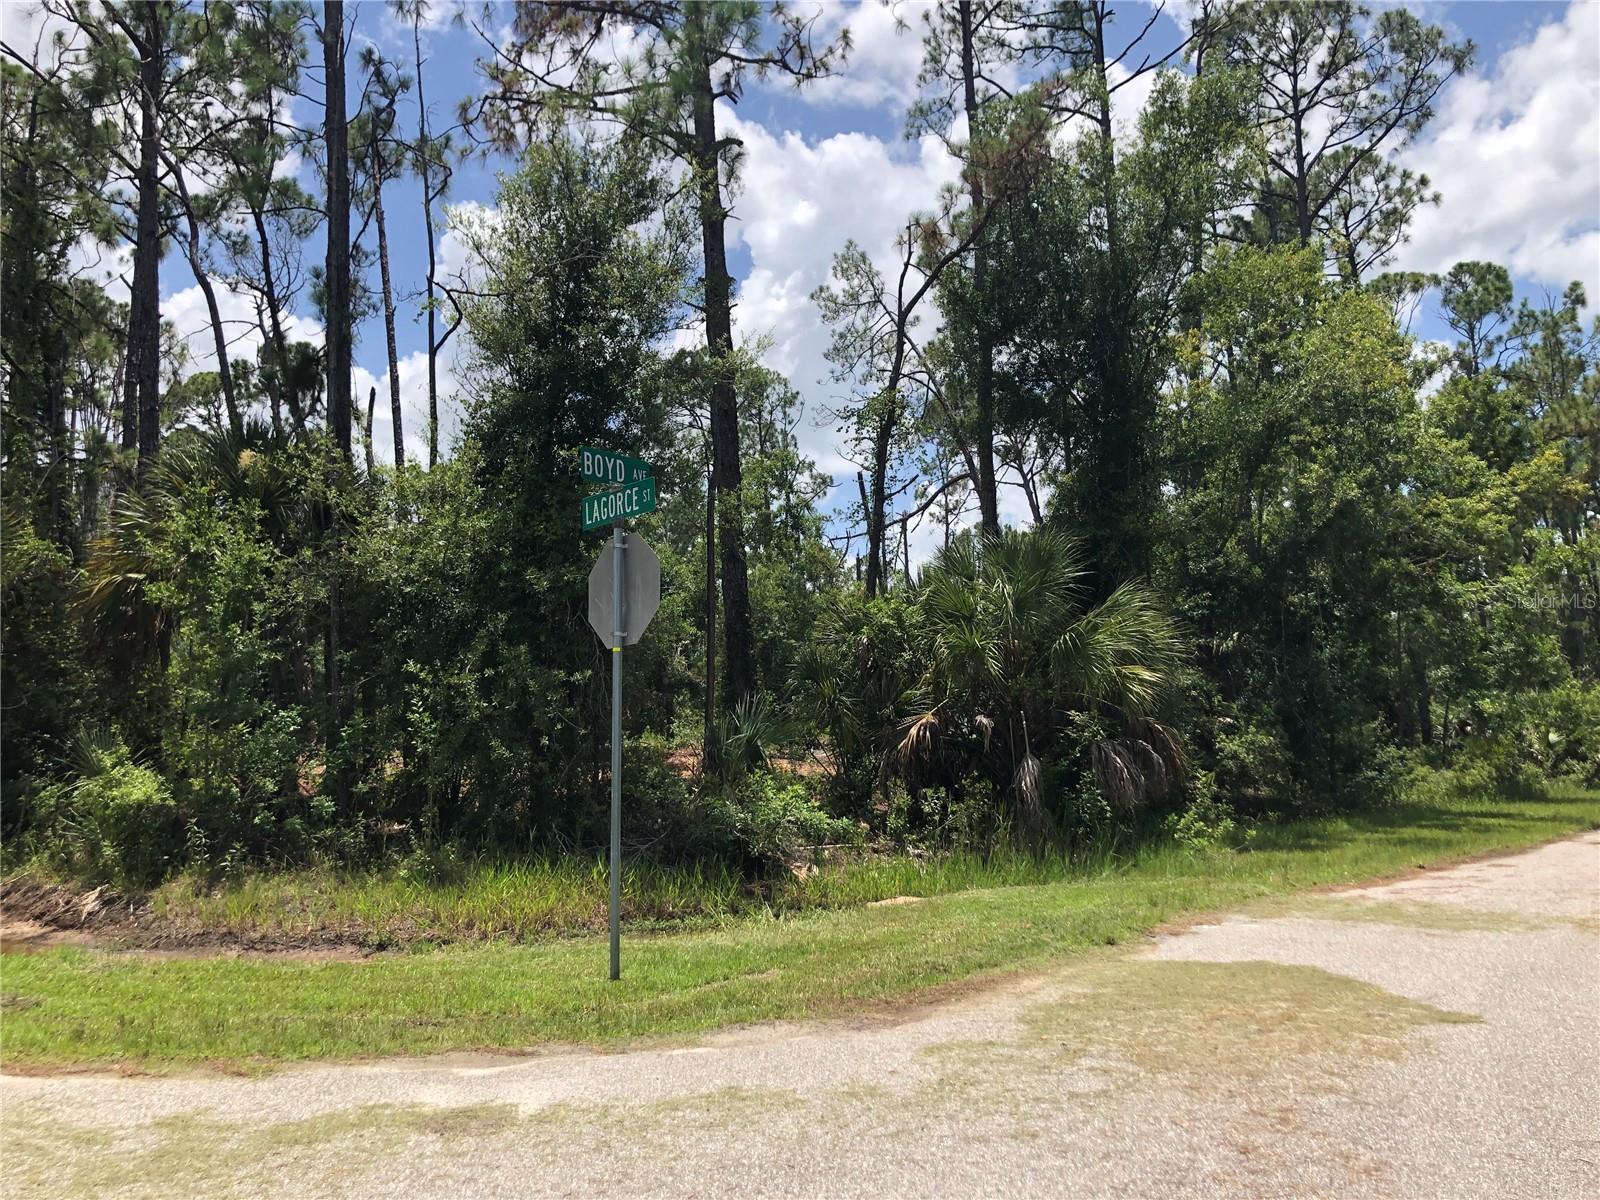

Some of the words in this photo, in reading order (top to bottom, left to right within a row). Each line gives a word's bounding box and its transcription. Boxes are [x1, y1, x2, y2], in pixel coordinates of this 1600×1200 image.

[583, 451, 625, 482] BOYD
[632, 468, 647, 481] AVE
[585, 487, 639, 525] LAGORCE
[642, 488, 651, 503] ST
